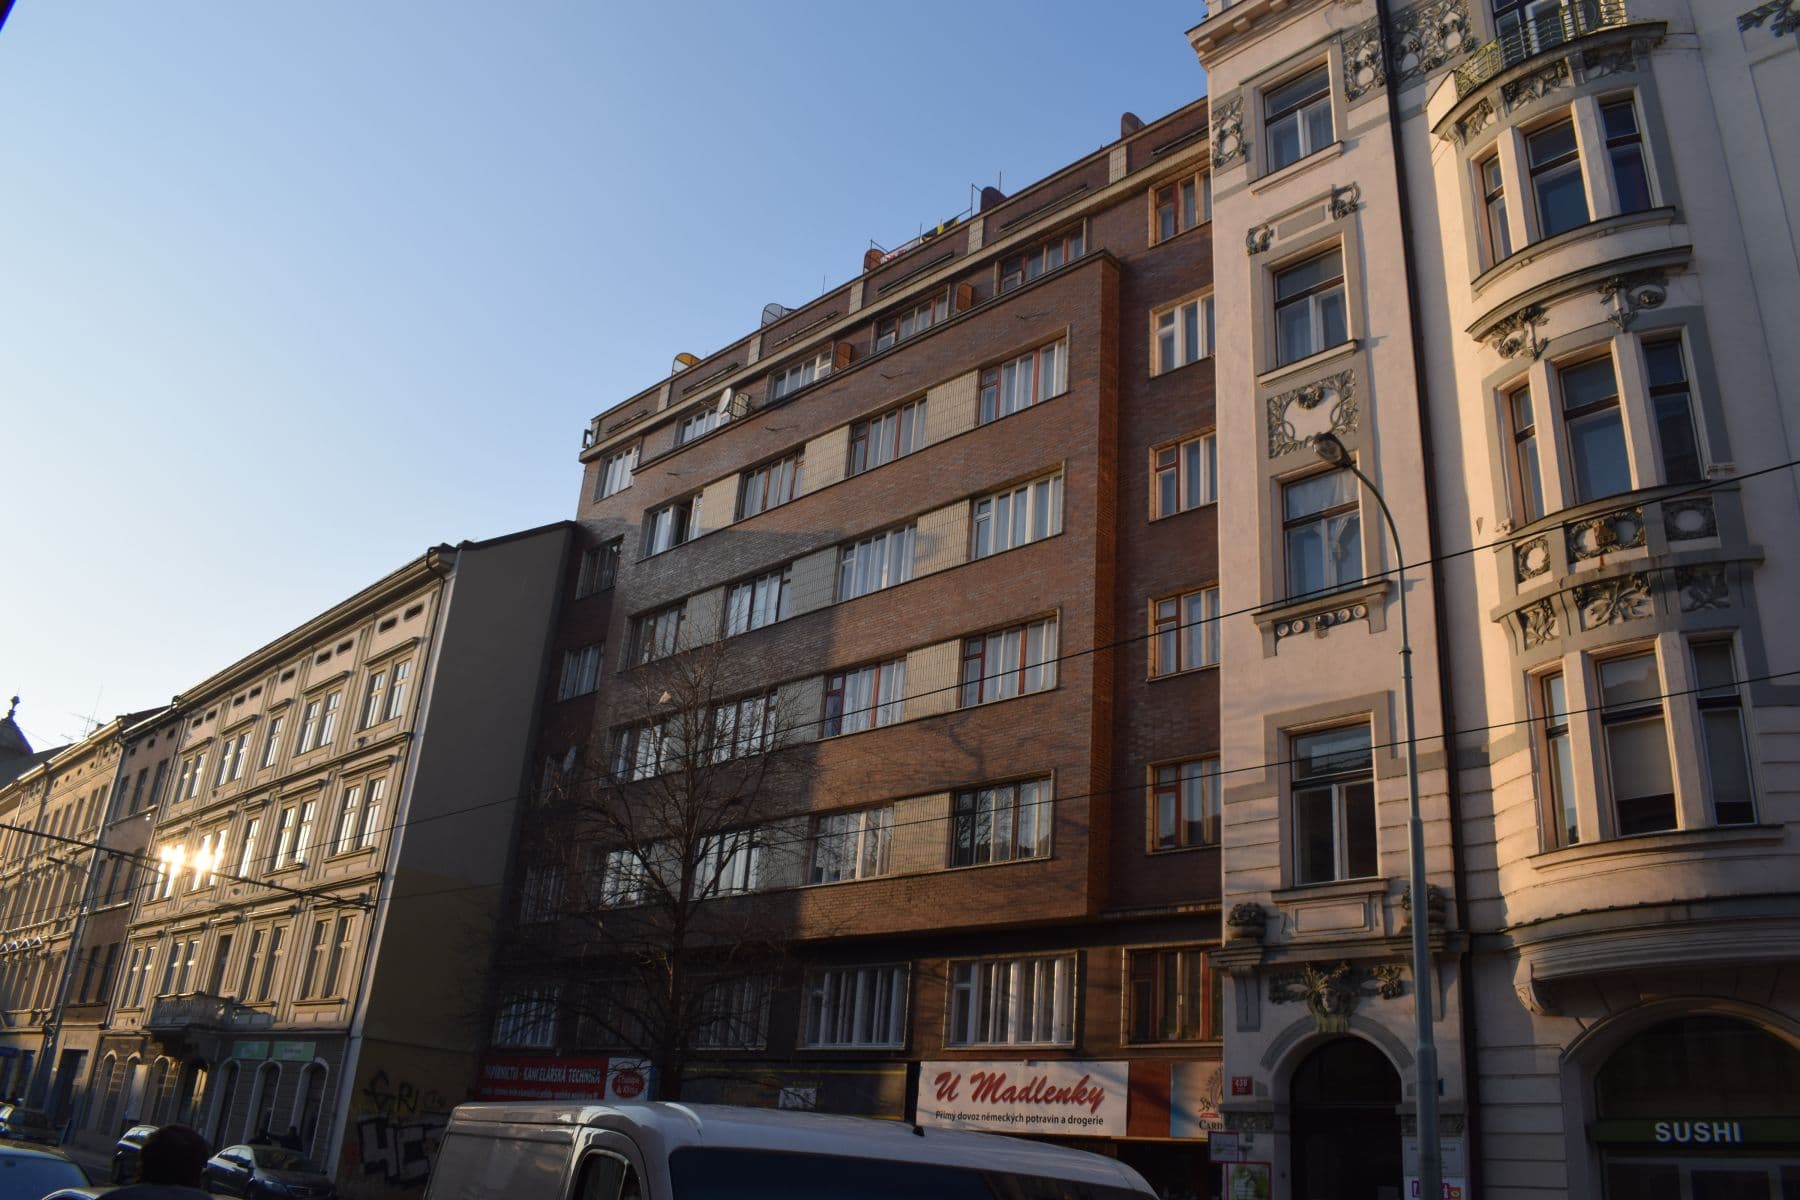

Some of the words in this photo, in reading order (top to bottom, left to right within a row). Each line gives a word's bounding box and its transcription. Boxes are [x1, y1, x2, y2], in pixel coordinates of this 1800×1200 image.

[934, 1071, 962, 1101] U
[970, 1071, 1105, 1114] Madlenky
[957, 1111, 980, 1121] dovoz
[981, 1113, 1024, 1124] německých
[1025, 1113, 1059, 1125] potravin
[1067, 1115, 1104, 1127] drogerie
[1654, 1121, 1743, 1144] SUSHI
